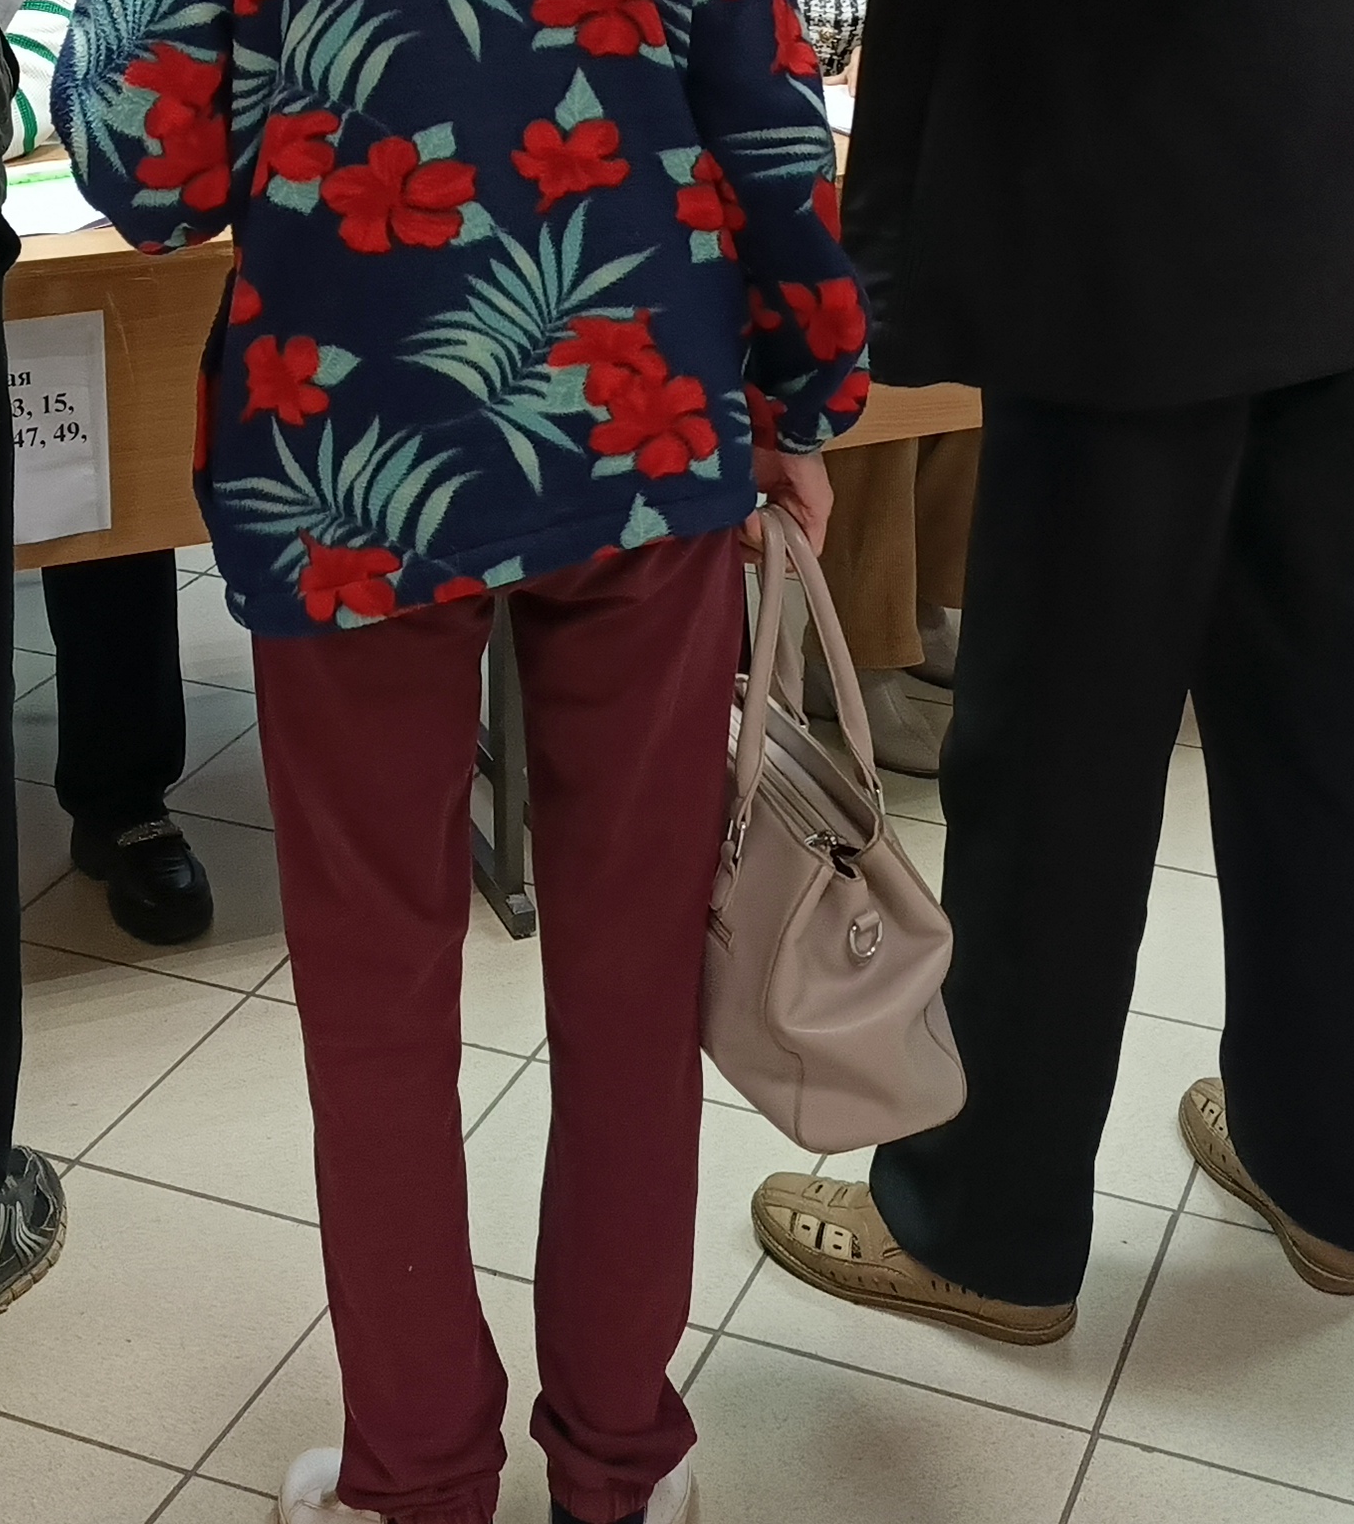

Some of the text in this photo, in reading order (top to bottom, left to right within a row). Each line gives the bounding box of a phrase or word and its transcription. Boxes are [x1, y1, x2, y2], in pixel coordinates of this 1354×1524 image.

[42, 392, 75, 415] 15,
[13, 421, 87, 449] 47, 49,
